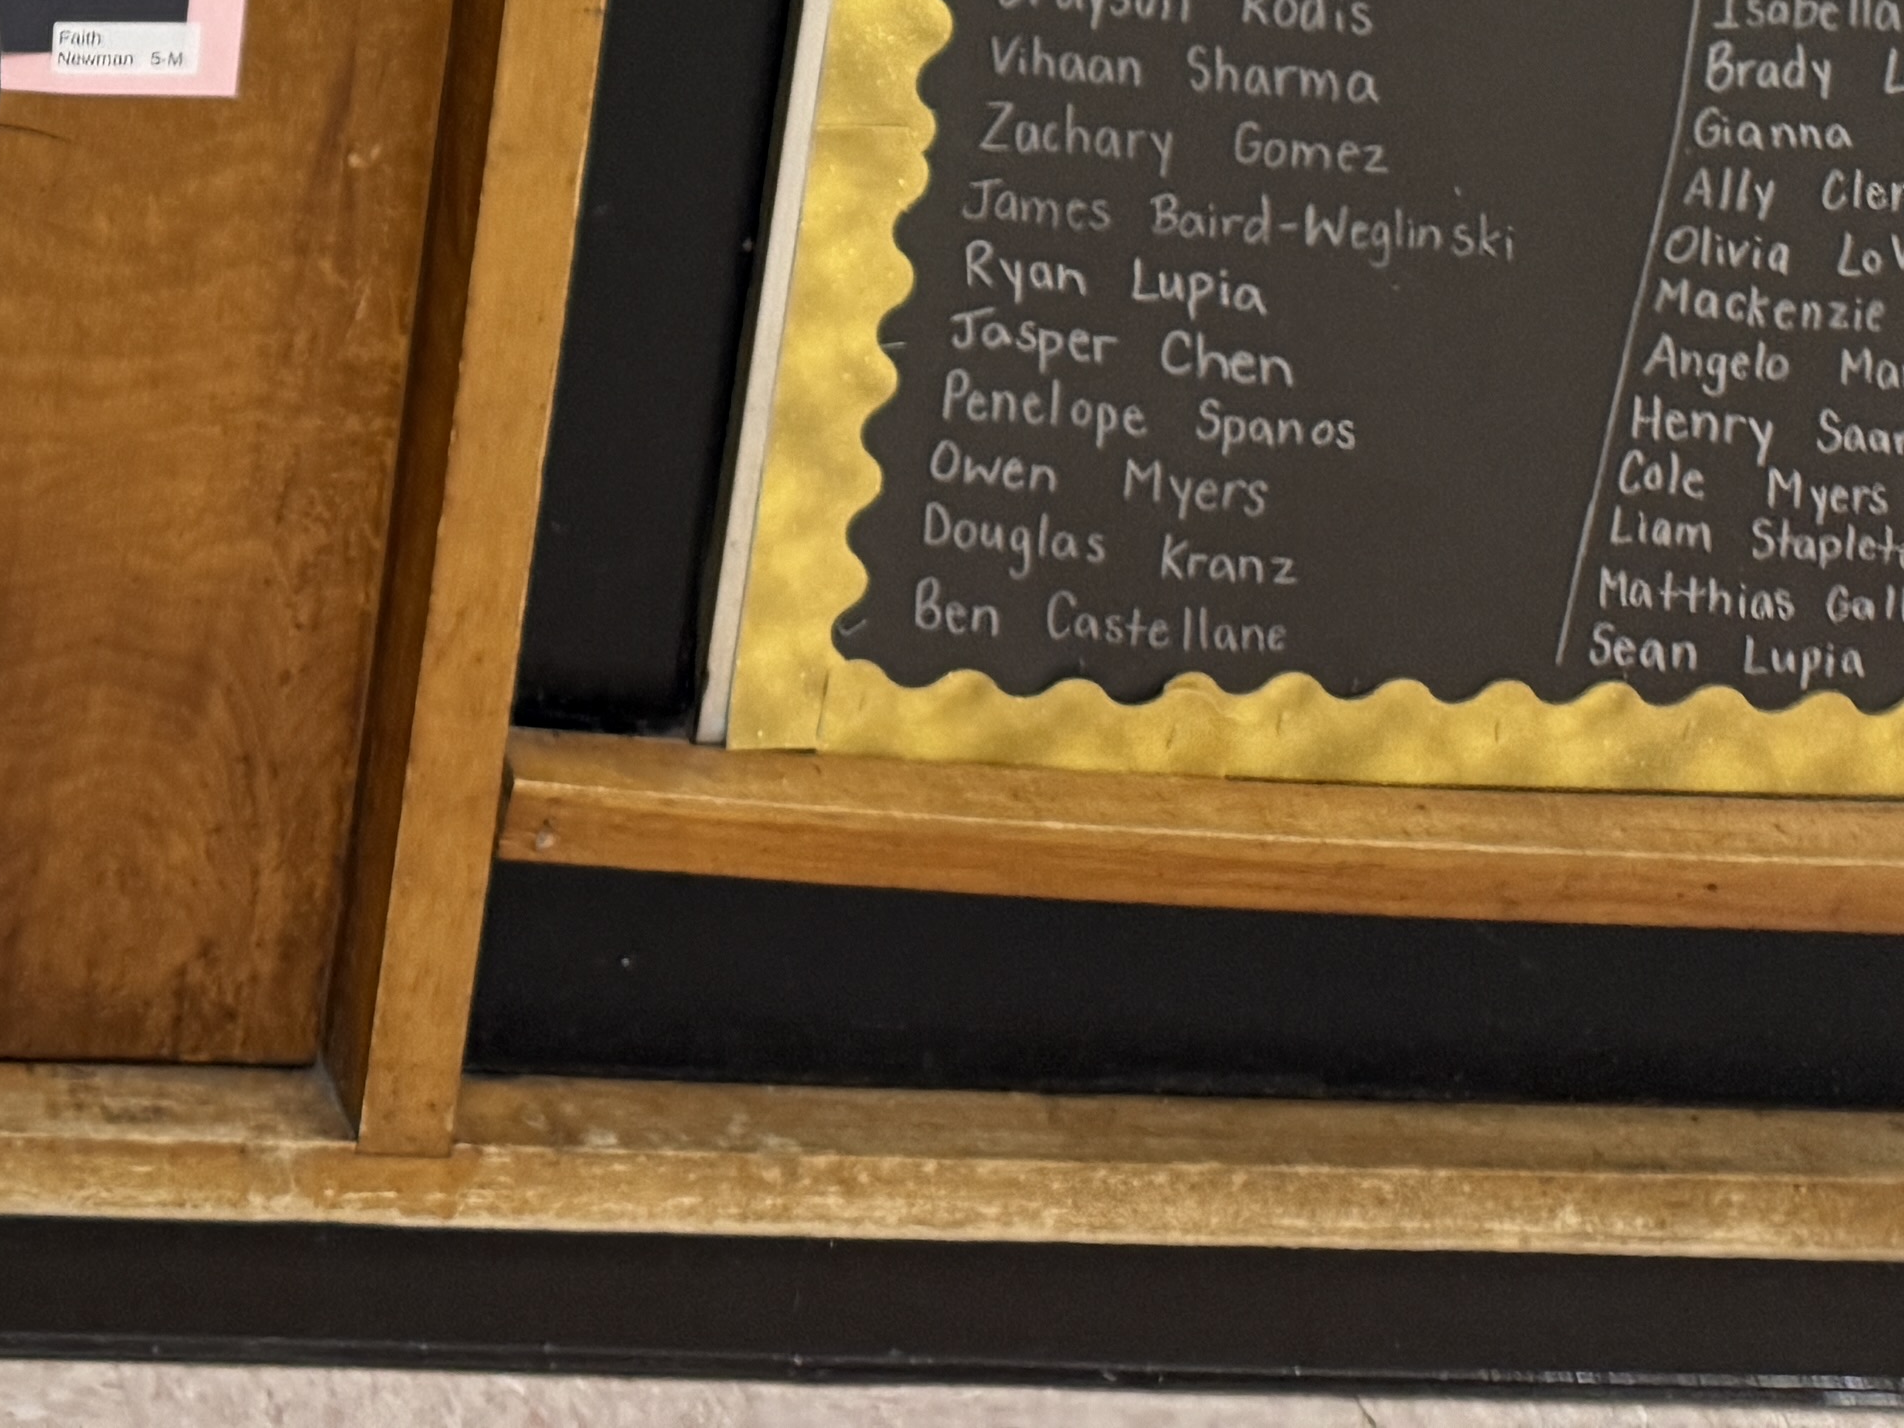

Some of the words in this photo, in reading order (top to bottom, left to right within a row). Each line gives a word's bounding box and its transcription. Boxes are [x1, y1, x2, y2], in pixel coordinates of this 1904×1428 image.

[58, 51, 134, 66] Newman
[151, 52, 183, 66] 5-M
[60, 30, 101, 45] Faith
[990, 34, 1143, 88] Vihaan
[1186, 44, 1381, 104] Sharma
[1704, 38, 1833, 101] Brady
[978, 100, 1174, 178] Zachary
[1233, 119, 1389, 174] Gomez
[1692, 105, 1855, 152] Gianna
[961, 177, 1112, 231] James
[1149, 192, 1514, 269] Baird-Weglinski
[1682, 166, 1777, 222] Ally
[964, 238, 1088, 305] Ryan
[1130, 256, 1269, 322] Lupia
[1663, 224, 1791, 277] Olivia
[1653, 277, 1886, 333] Mackenzie
[950, 305, 1119, 375] Jasper
[1159, 328, 1295, 388] Chen
[1641, 332, 1791, 399] Angelo
[941, 367, 1149, 450] Penelope
[1194, 397, 1357, 458] Spanos
[1630, 393, 1776, 468] Henry
[929, 438, 1058, 493] Owen
[1122, 457, 1270, 521] Myers
[1617, 447, 1706, 501] Cole
[1766, 466, 1890, 527] Myers
[922, 500, 1107, 581] Douglas
[1159, 532, 1298, 586] Kranz
[1608, 504, 1713, 554] Liam
[913, 576, 1001, 638] Ben
[1598, 564, 1797, 623] Matthias
[1587, 621, 1699, 674] Sean
[1742, 634, 1867, 691] Lupia
